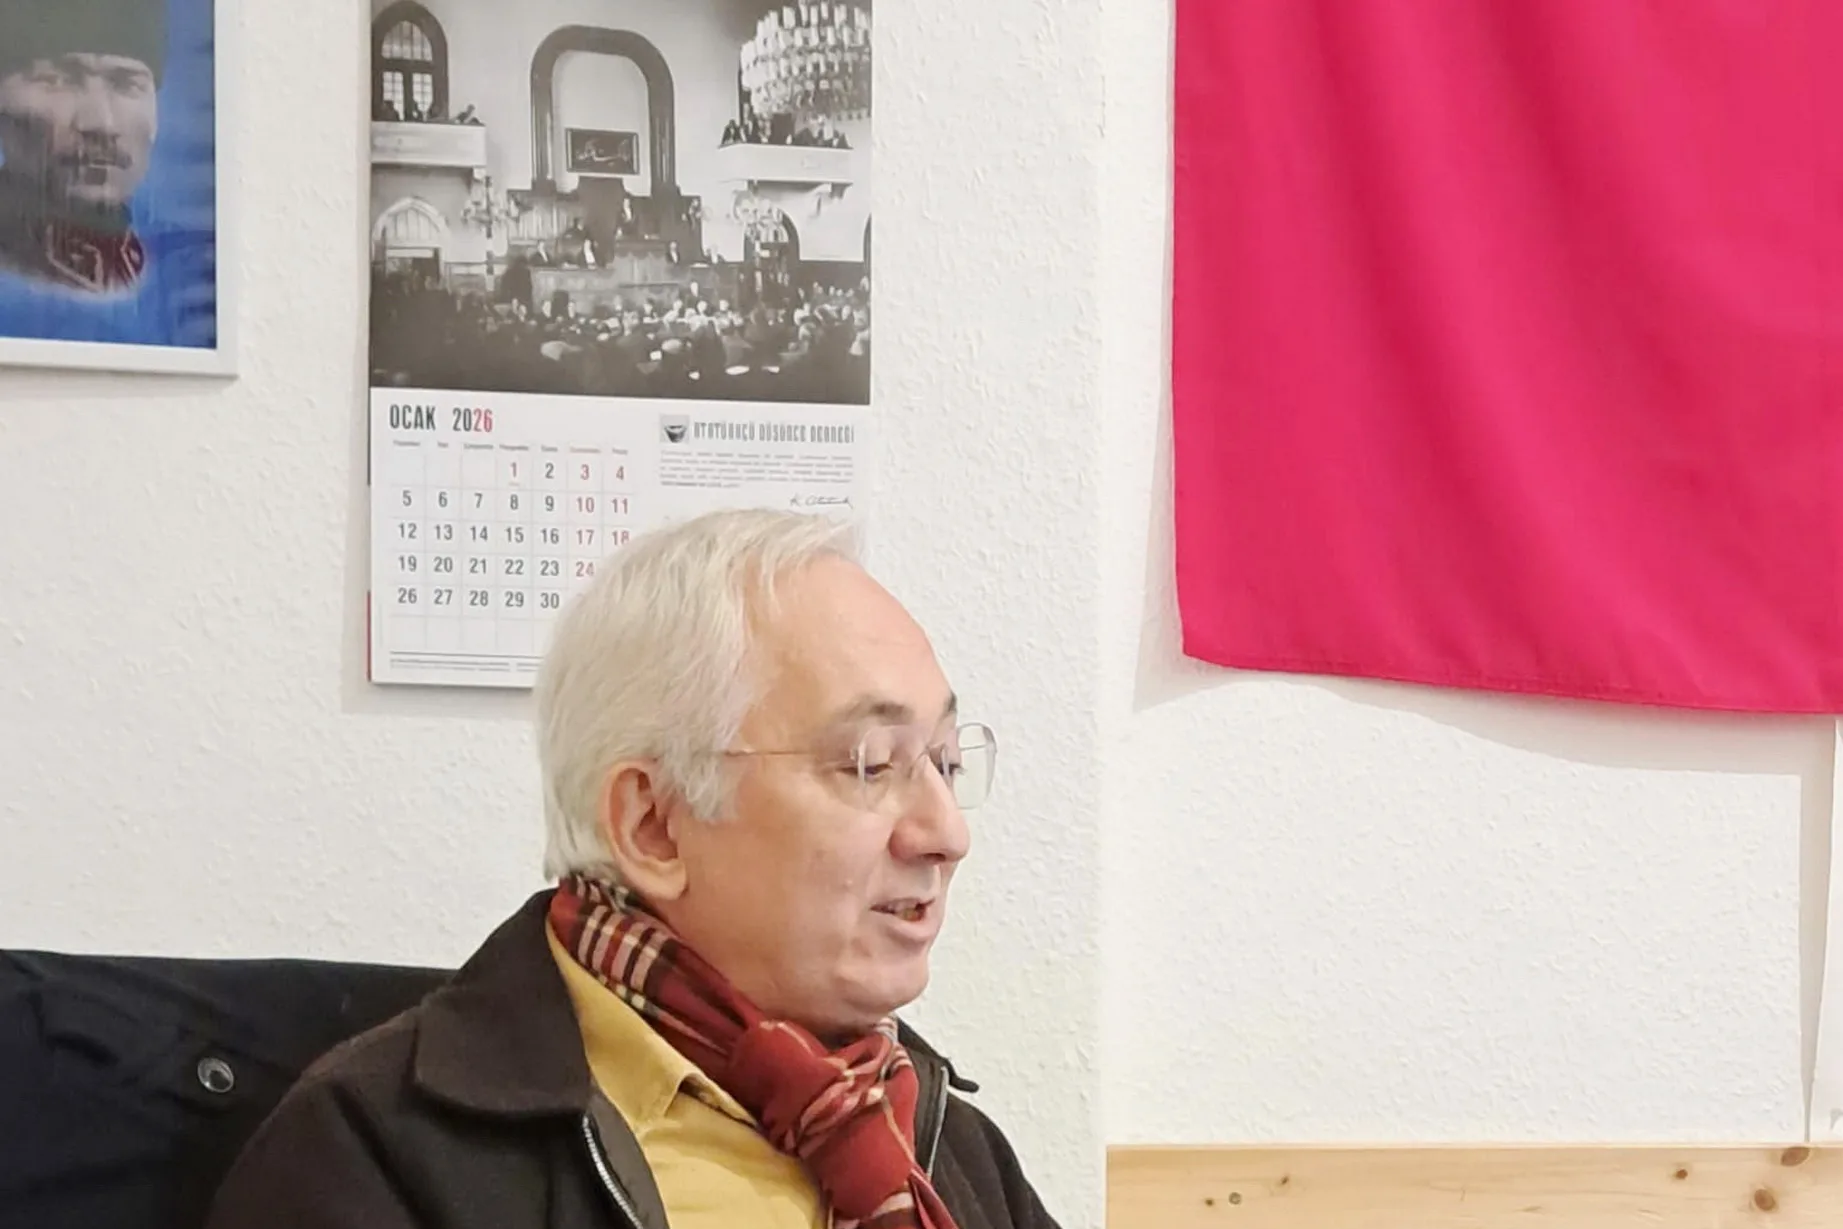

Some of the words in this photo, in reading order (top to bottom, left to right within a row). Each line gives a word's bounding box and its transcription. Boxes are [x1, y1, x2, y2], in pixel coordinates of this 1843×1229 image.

[390, 404, 436, 431] OCAK
[452, 407, 493, 433] 2026
[510, 462, 518, 478] 1
[545, 462, 554, 479] 2
[580, 464, 590, 480] 3
[615, 466, 625, 481] 4
[402, 490, 412, 507] 5
[438, 491, 448, 508] 6
[474, 493, 483, 509] 7
[510, 494, 519, 511] 8
[545, 495, 554, 512] 9
[576, 497, 595, 513] 10
[611, 498, 629, 515] 11
[398, 523, 417, 539] 12
[434, 524, 453, 540] 13
[470, 525, 488, 541] 14
[505, 527, 524, 543] 15
[540, 528, 560, 544] 16
[576, 529, 594, 545] 17
[612, 530, 629, 546] 18
[398, 555, 417, 572] 19
[434, 556, 453, 573] 20
[469, 558, 487, 574] 21
[505, 559, 524, 575] 22
[540, 560, 559, 577] 23
[575, 561, 594, 577] 24
[398, 587, 417, 604] 26
[434, 588, 453, 605] 27
[469, 590, 489, 606] 28
[505, 591, 524, 608] 29
[540, 592, 560, 609] 30
